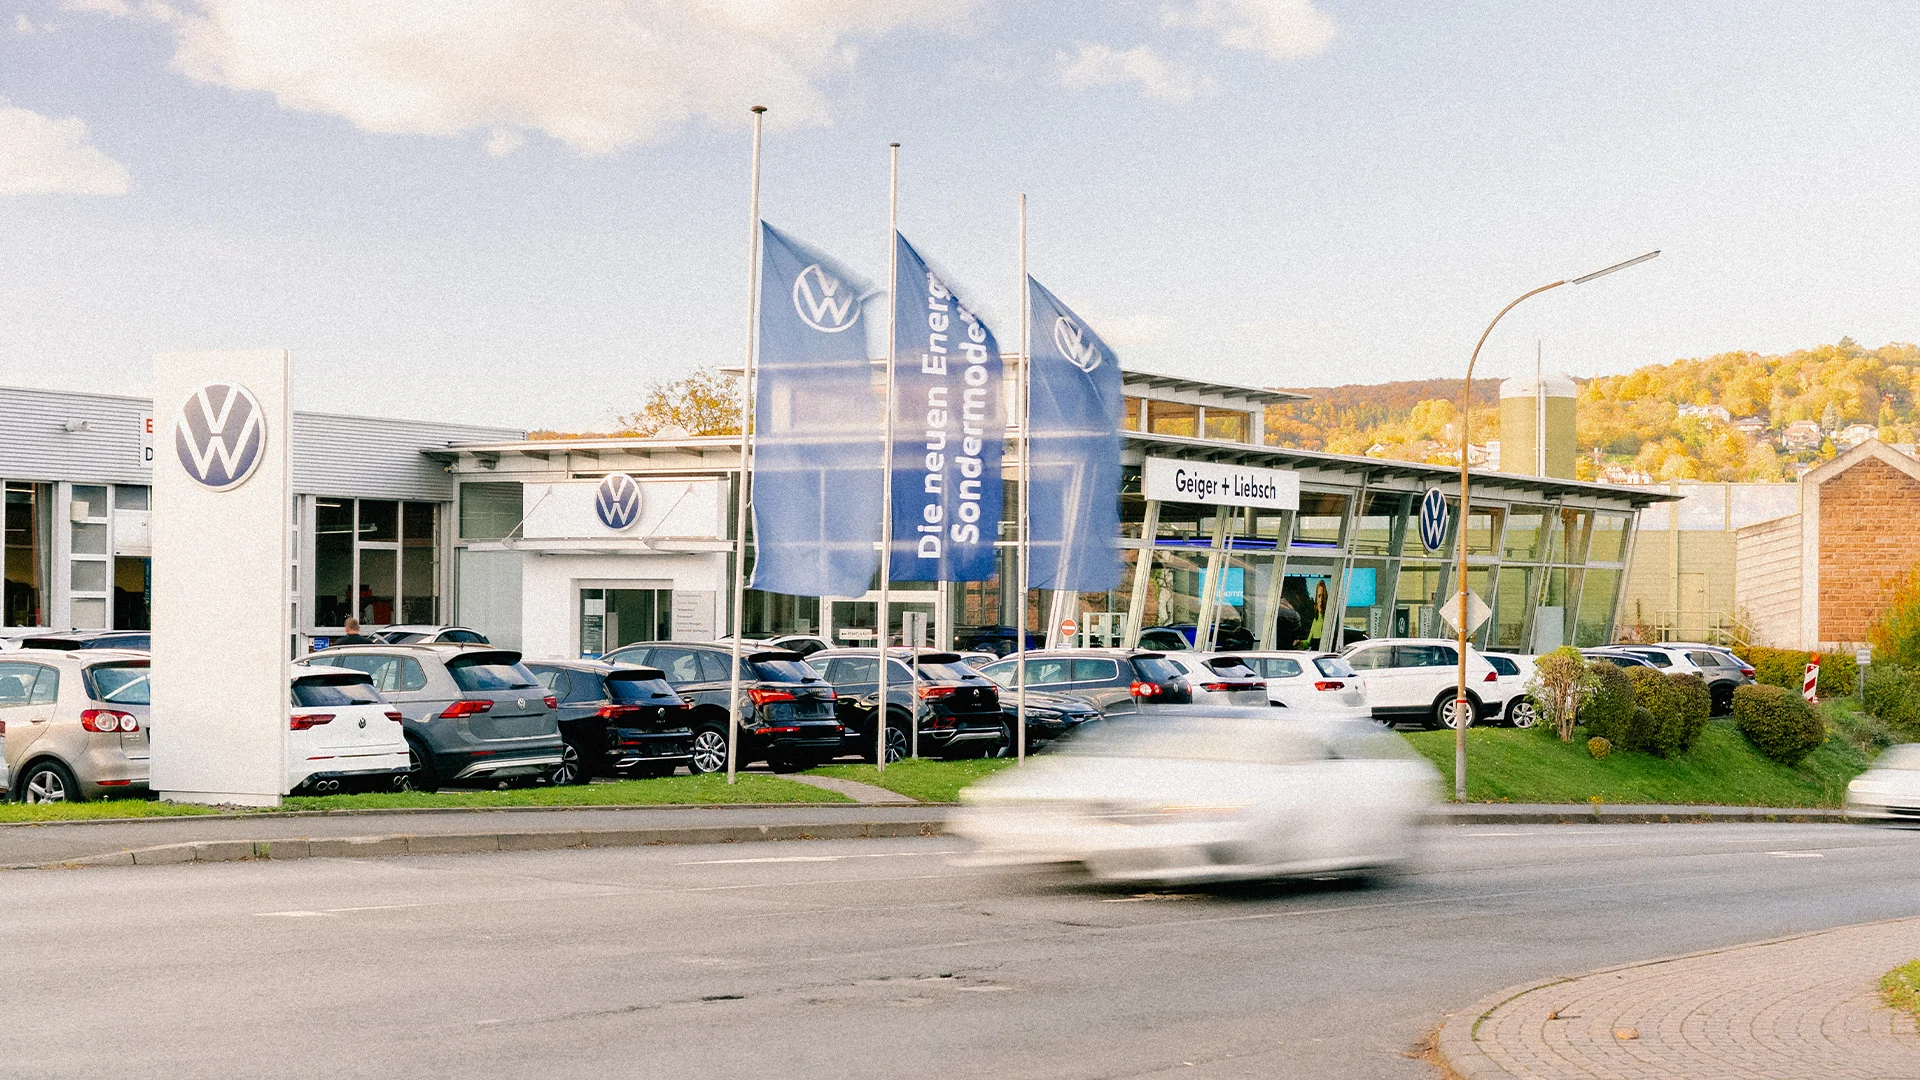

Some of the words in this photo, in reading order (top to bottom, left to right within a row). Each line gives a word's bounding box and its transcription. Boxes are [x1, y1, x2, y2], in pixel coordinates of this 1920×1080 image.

[921, 271, 951, 376] Energ
[924, 386, 949, 494] neuen
[1175, 468, 1218, 500] Geiger
[1234, 474, 1276, 499] Liebsch
[917, 503, 944, 558] Die
